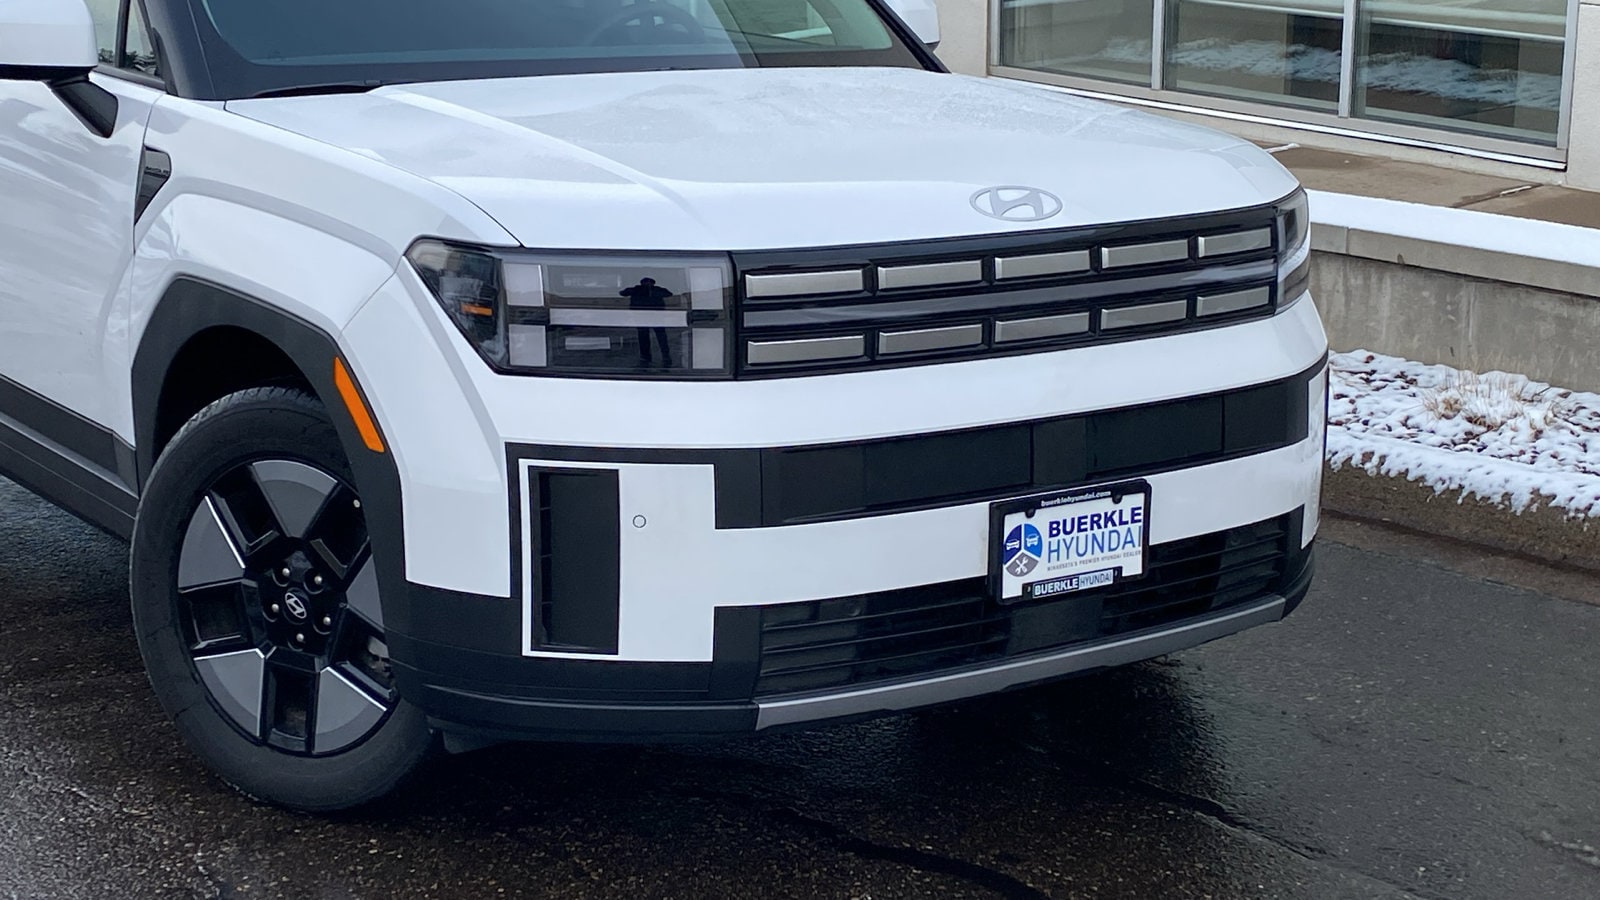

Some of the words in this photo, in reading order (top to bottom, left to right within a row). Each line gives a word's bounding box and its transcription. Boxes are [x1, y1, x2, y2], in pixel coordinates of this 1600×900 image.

[1041, 491, 1111, 507] buerklehyundai.com
[1049, 507, 1142, 538] BUERKLE
[1048, 525, 1142, 563] HYUNDAI
[1034, 577, 1079, 596] BUERKLE
[1079, 573, 1112, 587] HYUNDAI
